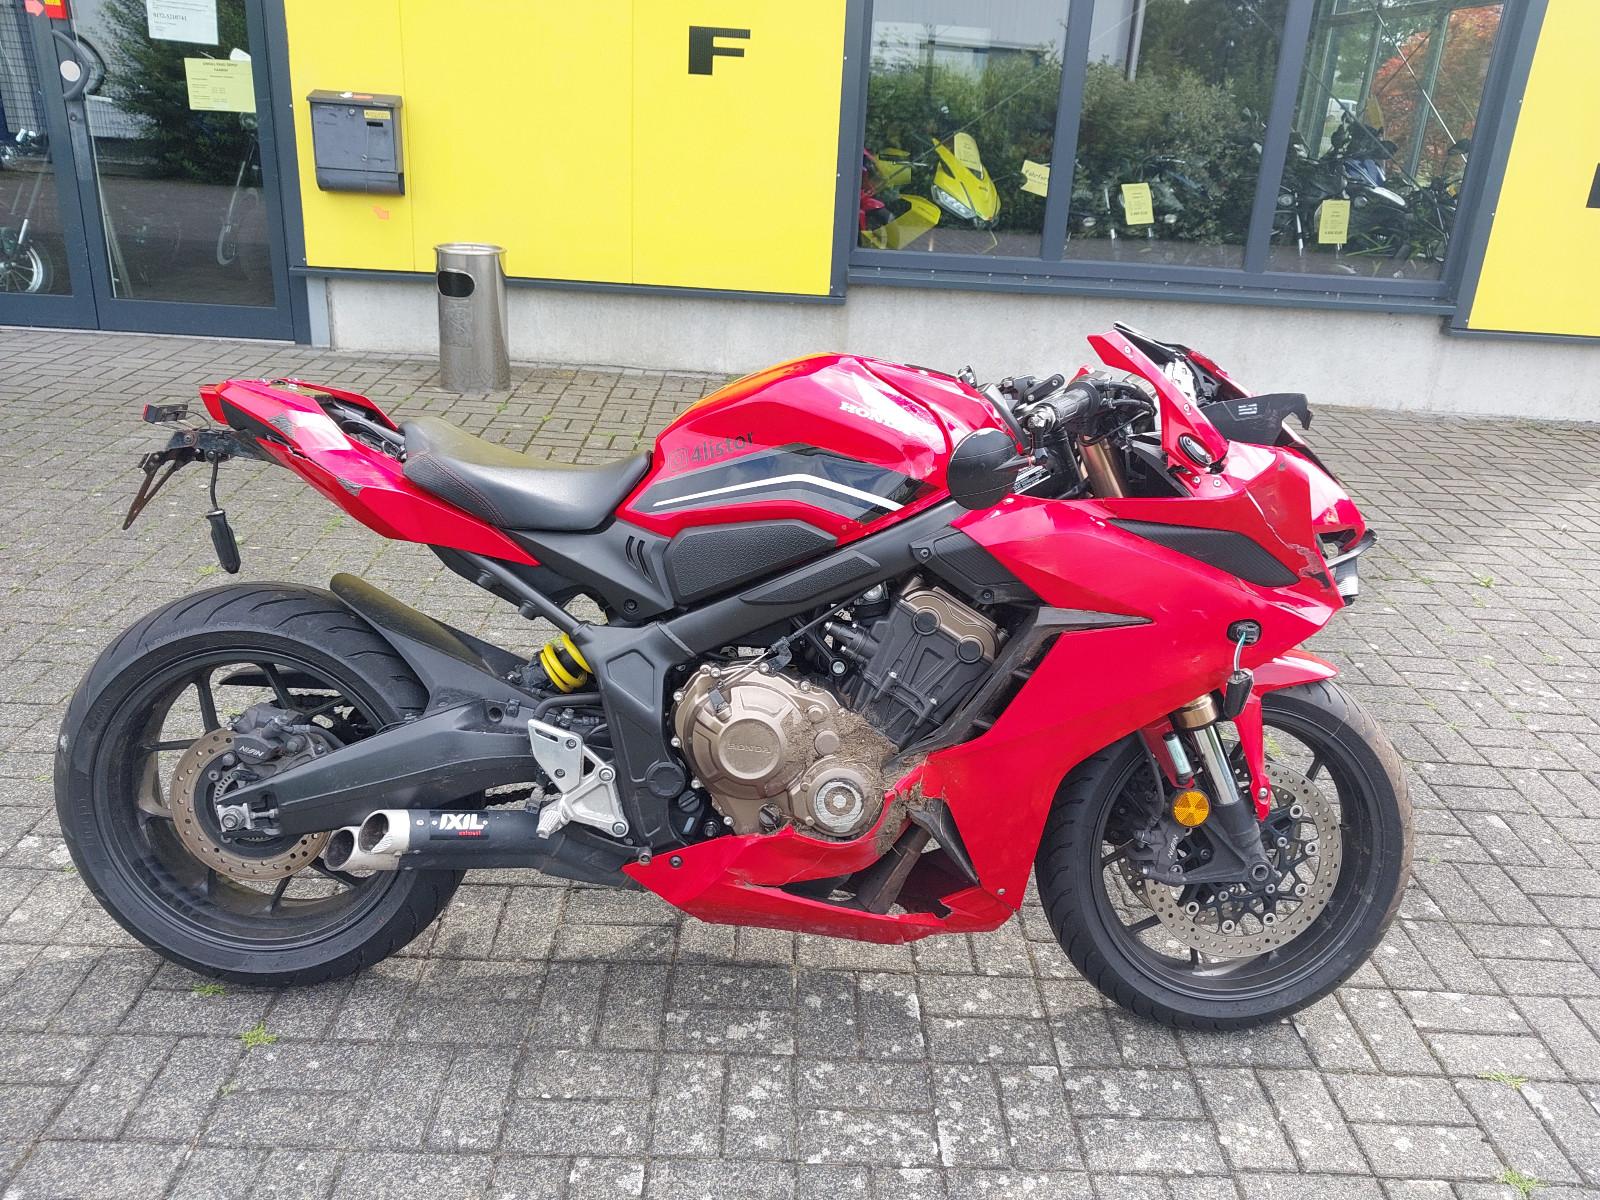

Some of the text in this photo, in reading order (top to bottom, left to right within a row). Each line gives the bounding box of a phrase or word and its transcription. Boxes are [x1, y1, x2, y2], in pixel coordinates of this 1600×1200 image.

[688, 26, 751, 75] F
[727, 743, 771, 755] HONDA
[438, 813, 485, 830] IXIL
